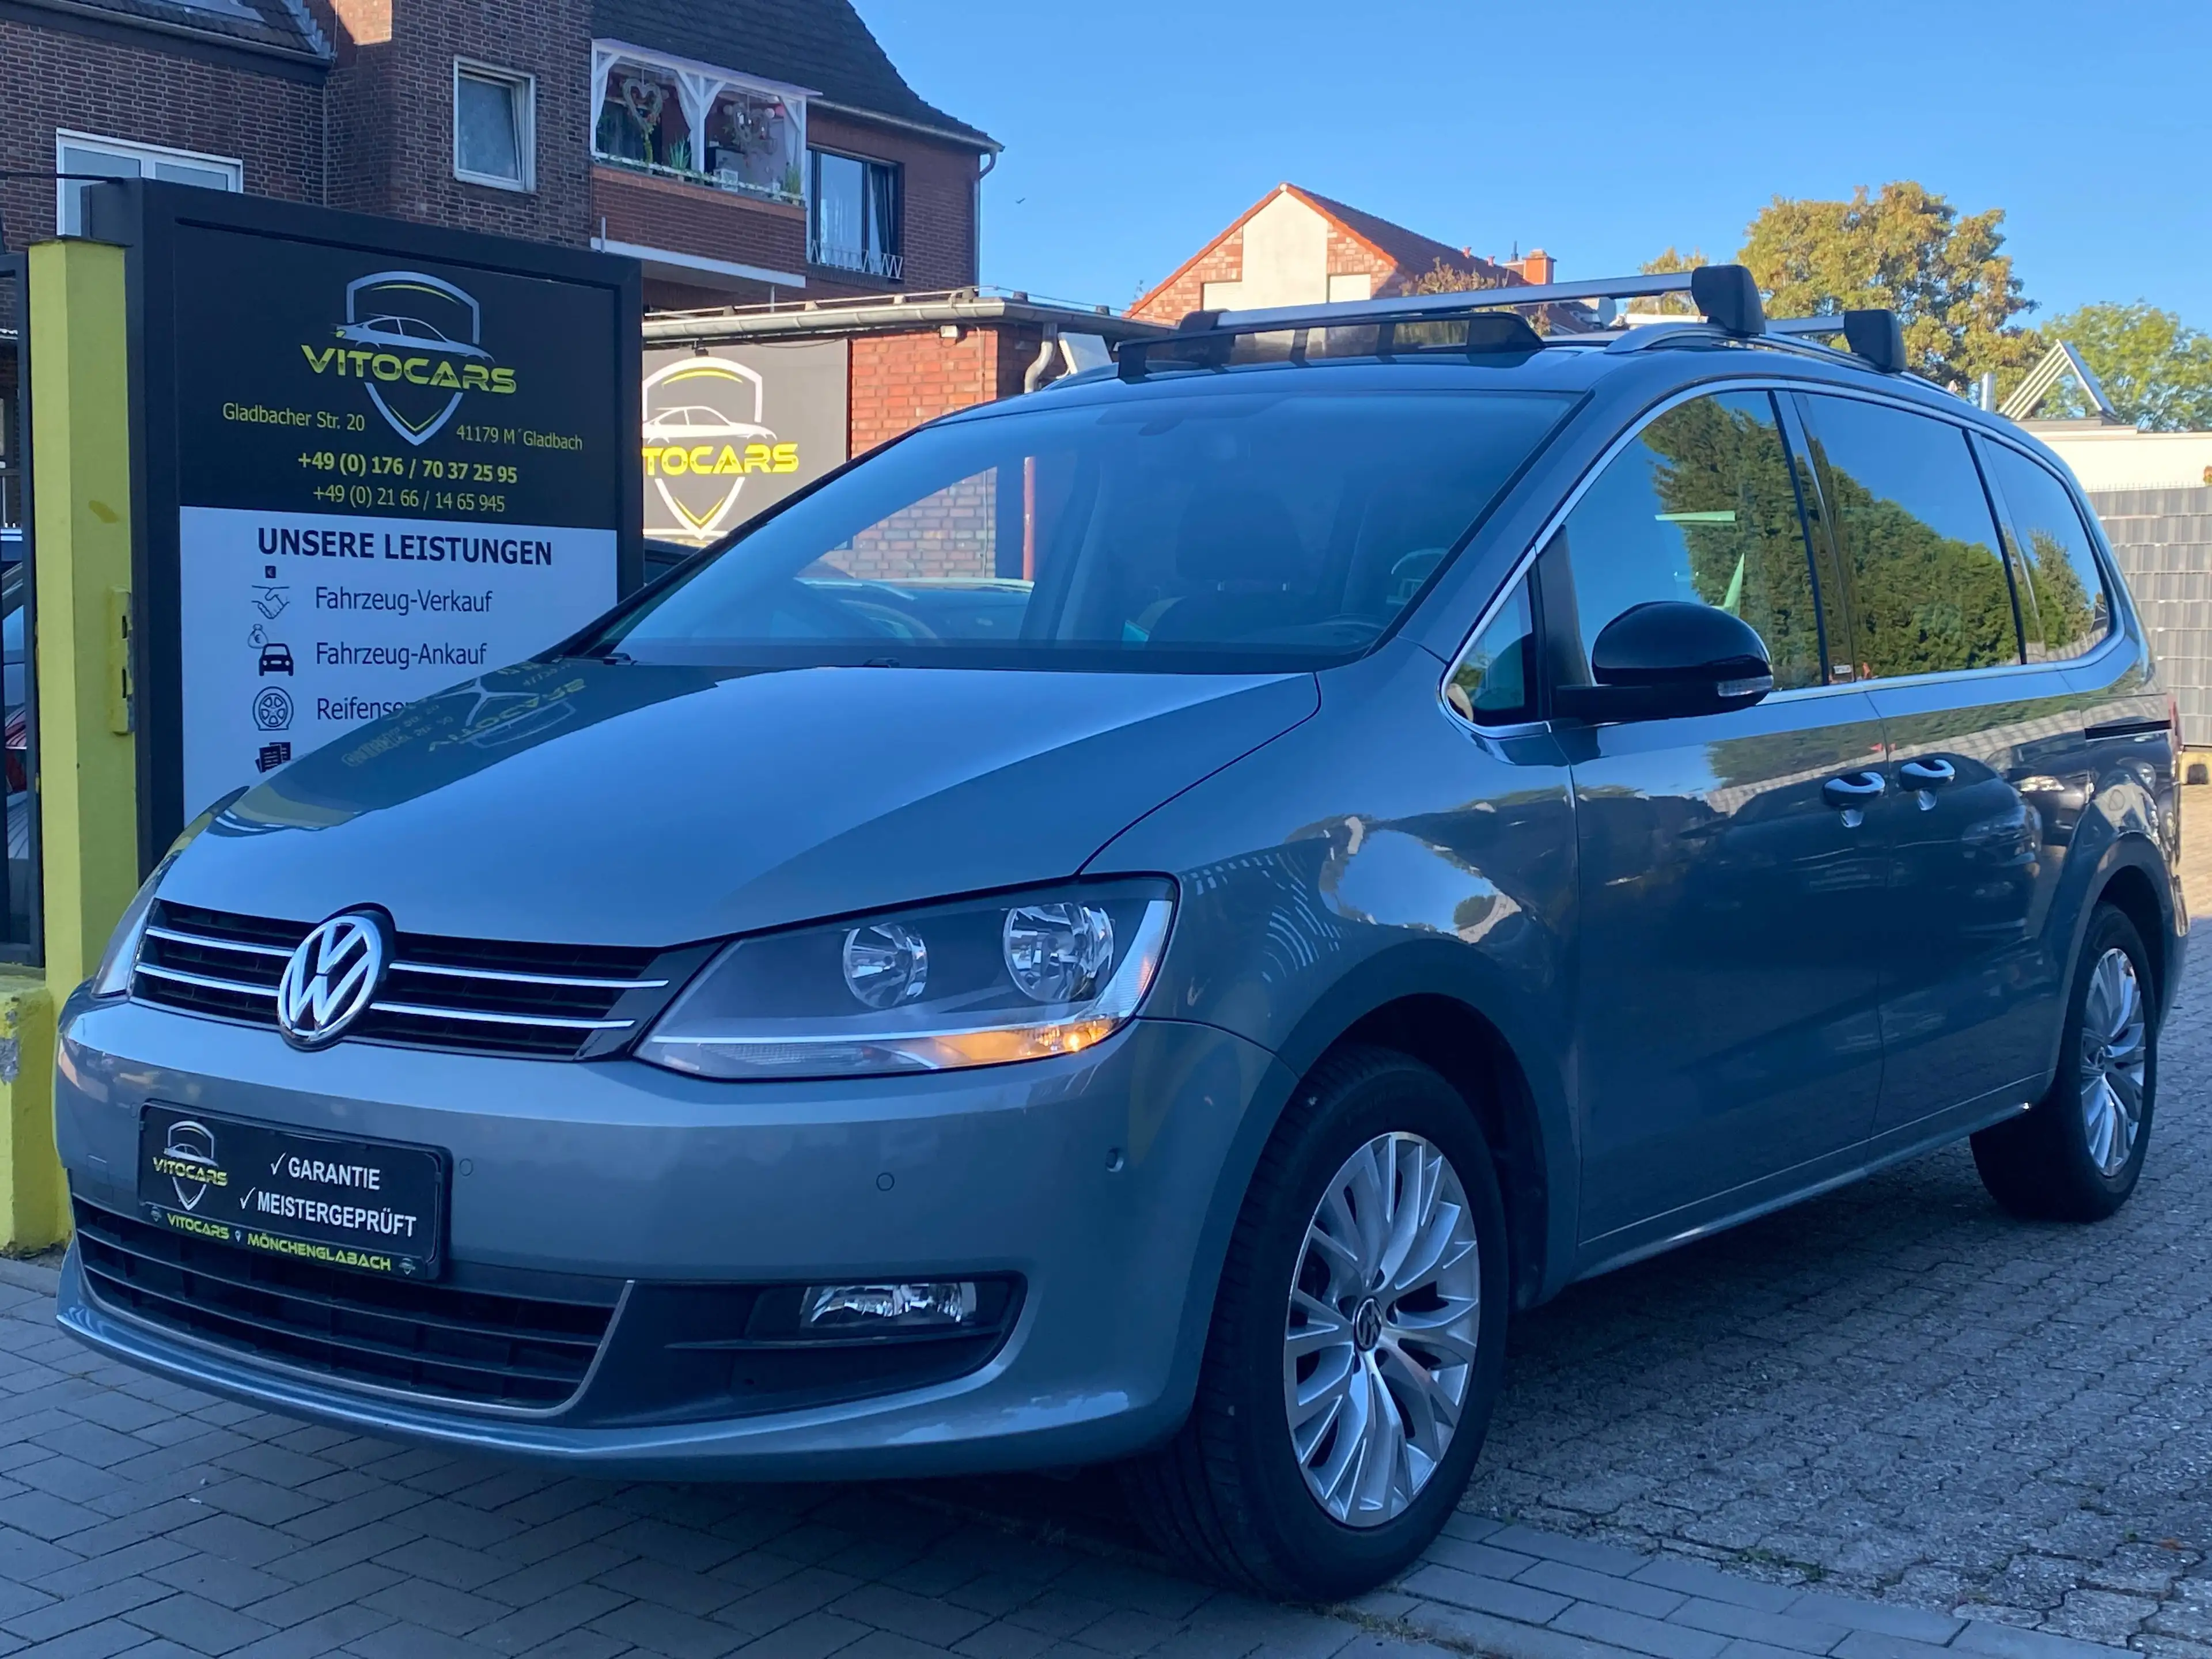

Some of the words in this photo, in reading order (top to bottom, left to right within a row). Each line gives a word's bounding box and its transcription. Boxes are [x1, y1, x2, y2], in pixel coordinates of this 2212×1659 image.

[301, 344, 516, 394] VITOCARS
[222, 403, 312, 426] Gladbacher
[316, 411, 340, 429] Str.
[346, 414, 365, 431] 20
[456, 425, 499, 443] 41179
[298, 452, 335, 470] +49
[340, 453, 366, 477] (0)
[372, 456, 403, 475] 176
[408, 459, 416, 479] /
[423, 460, 443, 478] 70
[448, 463, 468, 480] 37
[473, 464, 493, 482] 25
[498, 466, 517, 484] 95
[642, 444, 799, 475] TOCARS
[313, 484, 344, 502] +49
[350, 485, 372, 508] (0)
[377, 487, 395, 506] 21
[400, 489, 419, 507] 66
[423, 490, 430, 511] /
[435, 492, 452, 509] 14
[457, 493, 474, 510] 65
[479, 495, 505, 512] 945
[257, 527, 374, 558] UNSERE
[384, 535, 552, 565] LEISTUNGEN
[316, 586, 493, 616] Fahrzeug-Verkauf
[316, 642, 487, 670] Fahrzeug-Ankauf
[278, 916, 381, 1041] VW
[153, 1157, 228, 1186] VITOCARS
[288, 1157, 380, 1190] GARANTIE
[167, 1213, 229, 1240] VITOCARS
[257, 1191, 417, 1237] MEISTERGEPRÜFT
